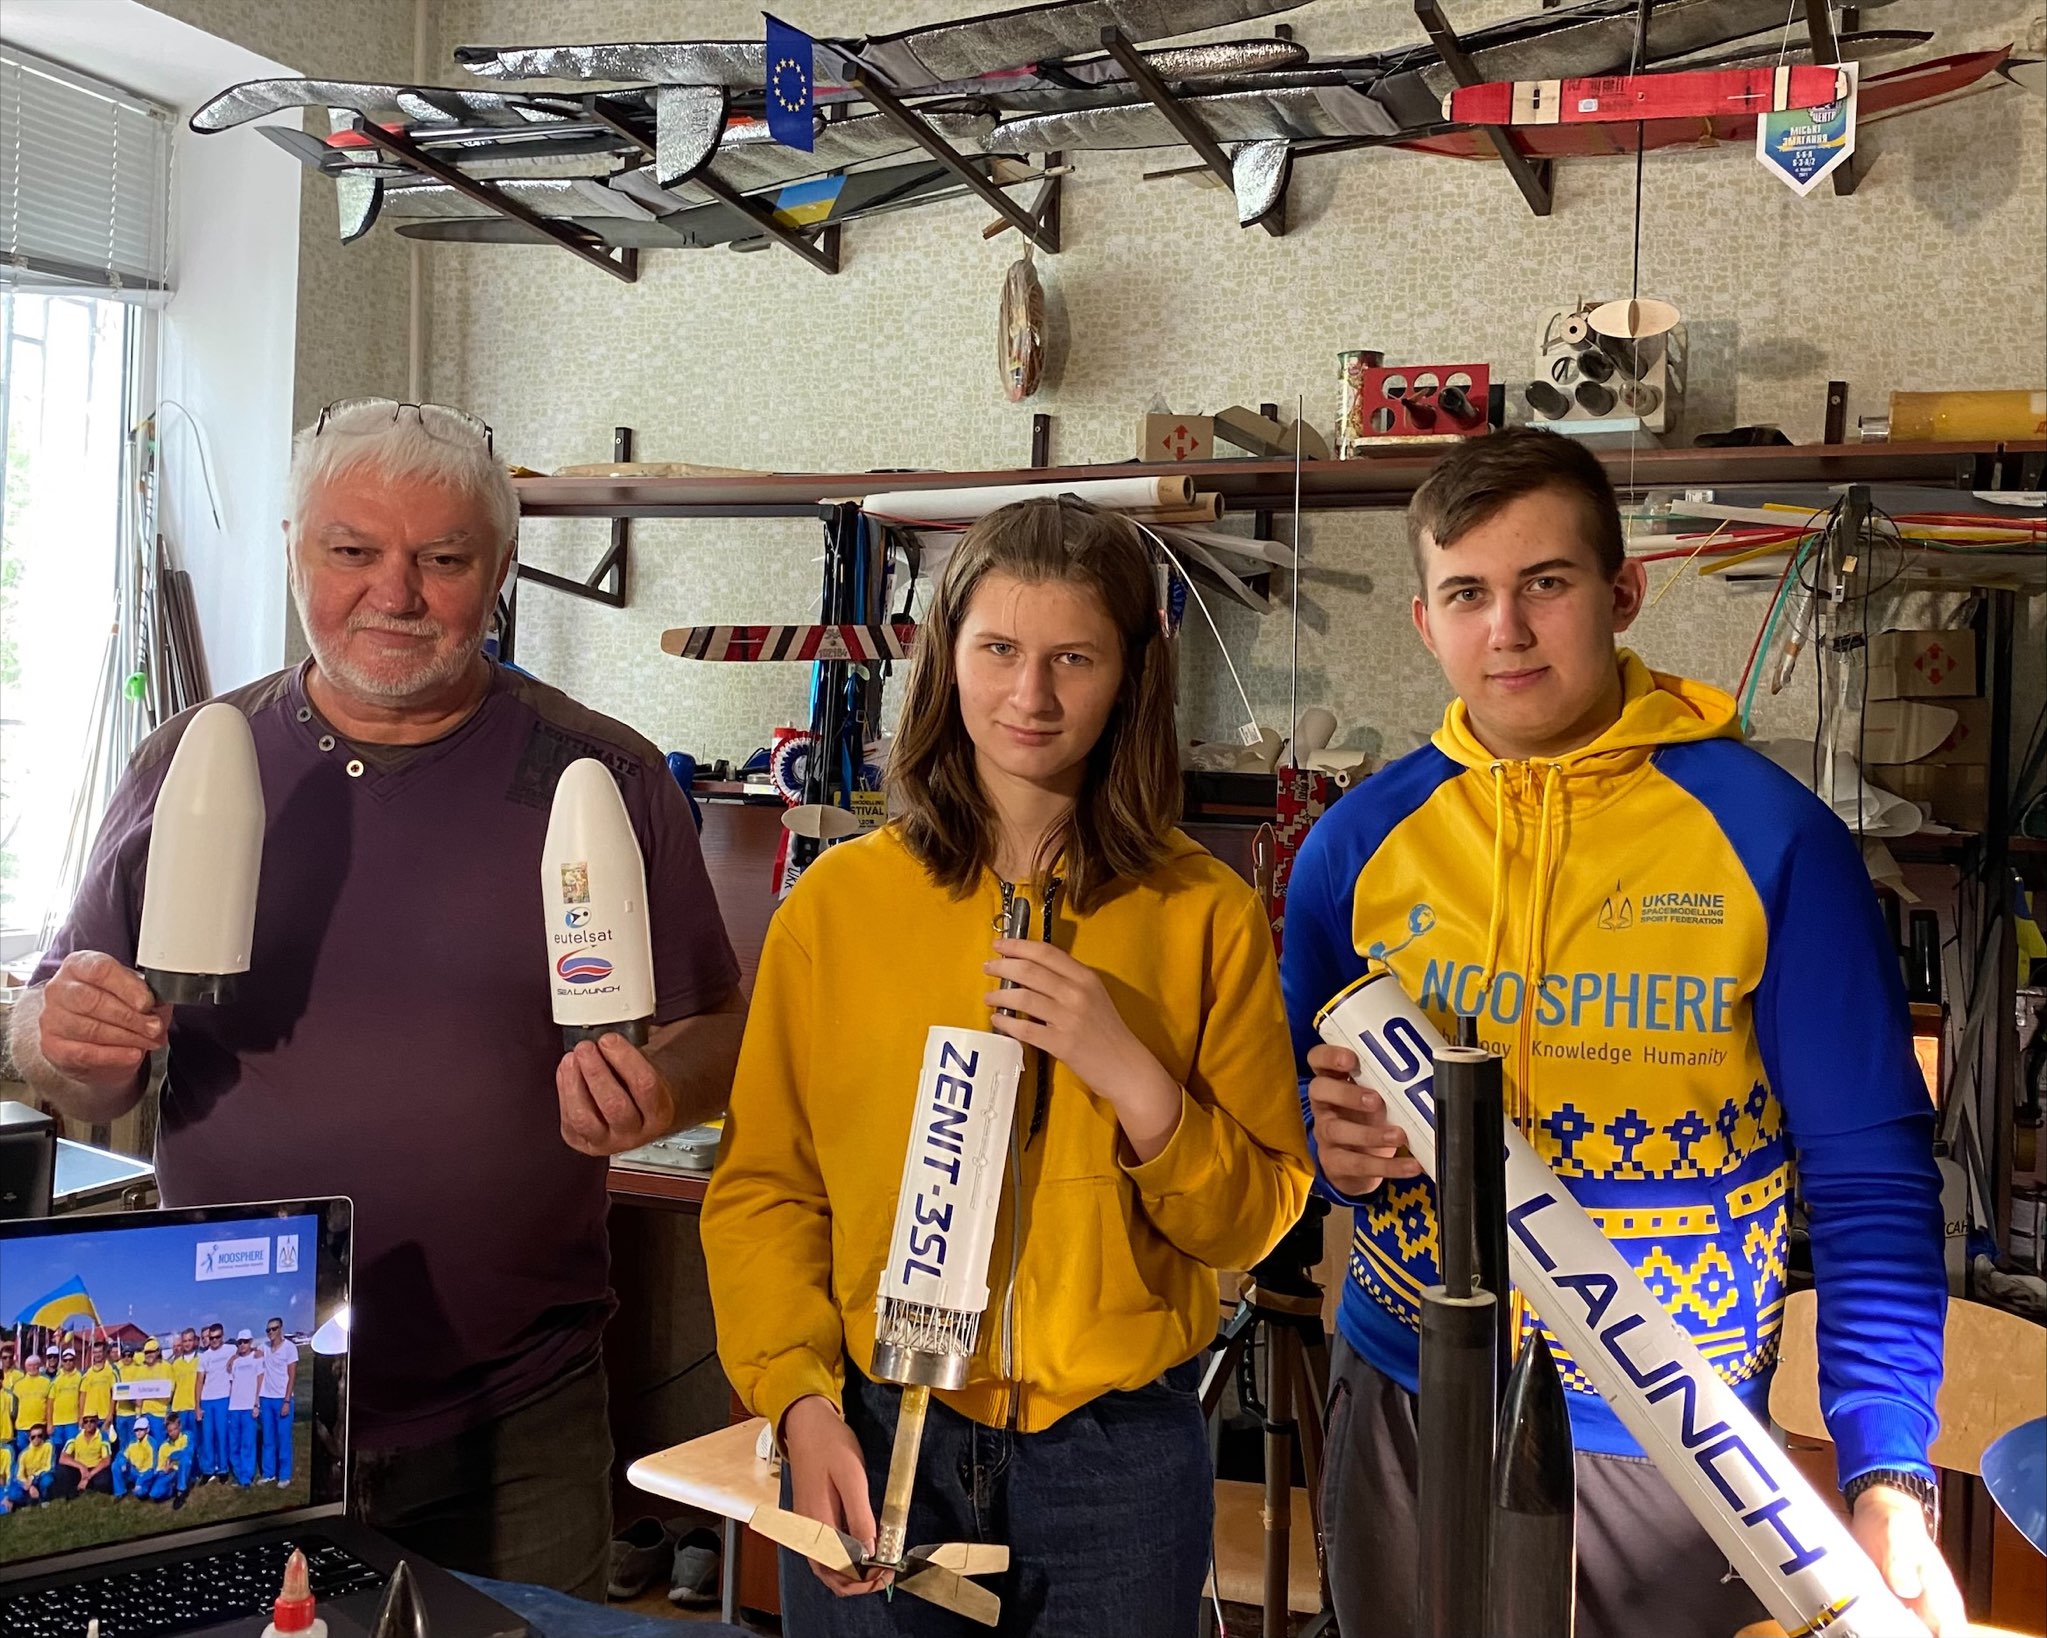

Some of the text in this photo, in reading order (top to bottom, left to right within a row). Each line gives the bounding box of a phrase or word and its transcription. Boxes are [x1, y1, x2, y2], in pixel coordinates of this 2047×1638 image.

[1790, 125, 1821, 136] МІСЬКІ
[850, 806, 885, 816] STIVAL
[1642, 893, 1725, 908] UKRAINE
[1641, 907, 1724, 916] SPACEMODELLING
[1640, 915, 1724, 925] SPORT FEDERATION
[554, 929, 613, 944] eutelsat
[1419, 957, 1738, 1034] NOOSPHERE
[1532, 1039, 1632, 1065] Knowledge
[1643, 1043, 1728, 1066] Humanity
[218, 1250, 265, 1264] NOOSPHERE
[1507, 1192, 1828, 1577] LAUNCH
